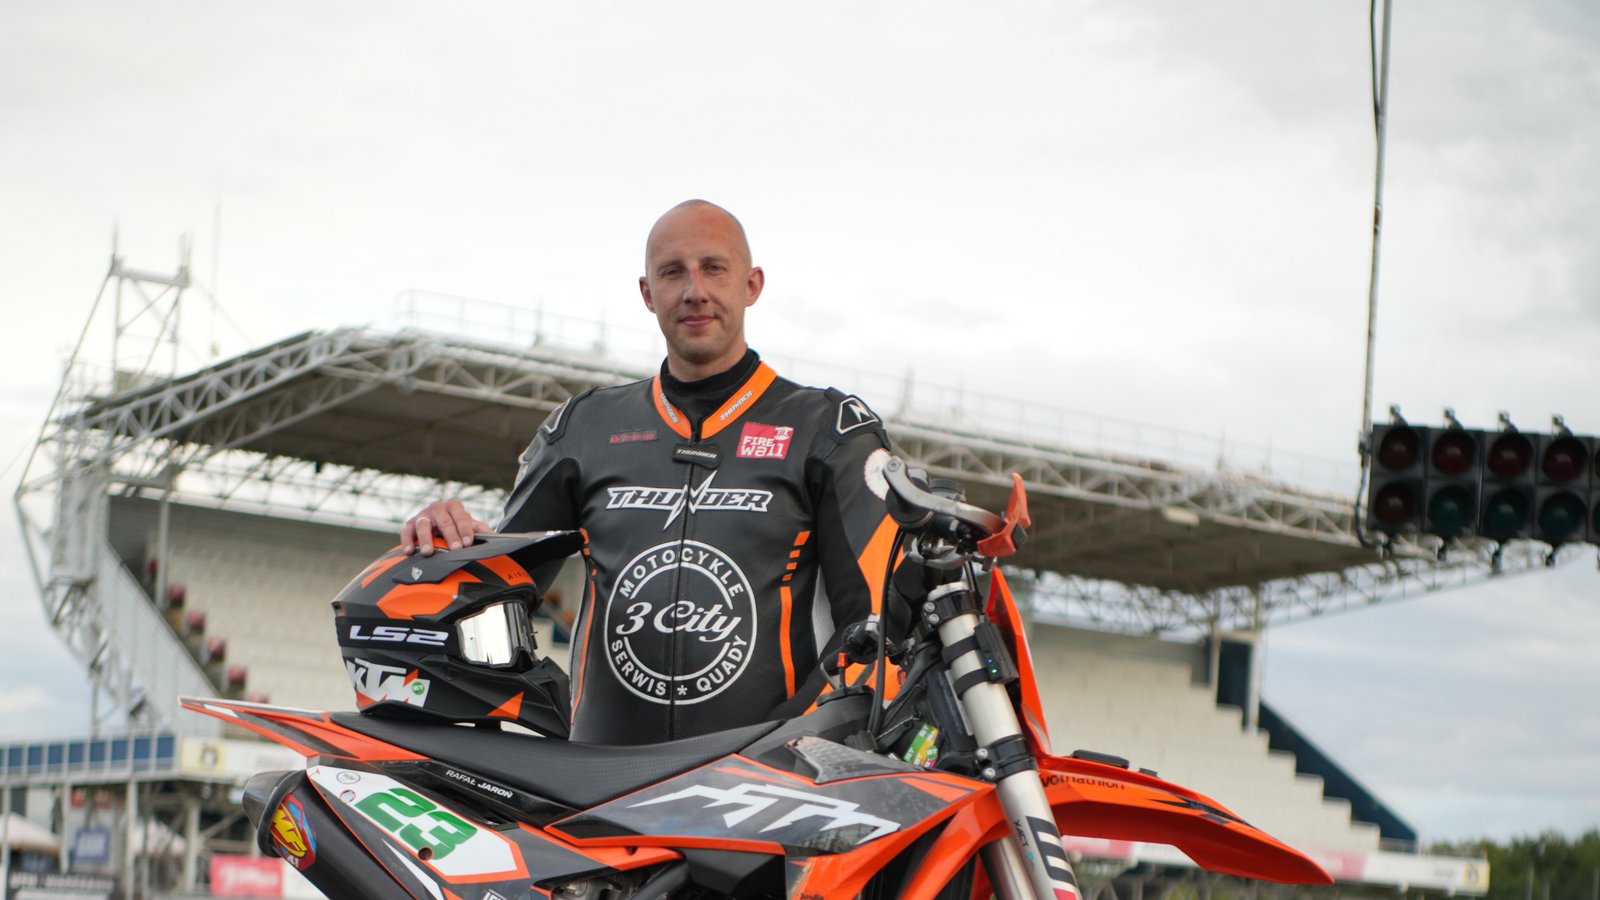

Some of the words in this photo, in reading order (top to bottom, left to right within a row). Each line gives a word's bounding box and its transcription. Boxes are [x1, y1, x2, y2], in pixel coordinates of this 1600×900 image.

[719, 390, 752, 421] THUNDER
[676, 448, 718, 459] THUNDER
[743, 435, 775, 447] FIRE
[606, 469, 773, 531] THUNDER
[618, 547, 744, 598] MOTOCYKLE
[349, 624, 449, 646] LS2
[615, 601, 653, 635] 3
[653, 600, 743, 642] City
[346, 657, 430, 708] KTM
[611, 639, 667, 696] SERWIS
[696, 635, 748, 693] QUADY
[354, 786, 478, 860] 23
